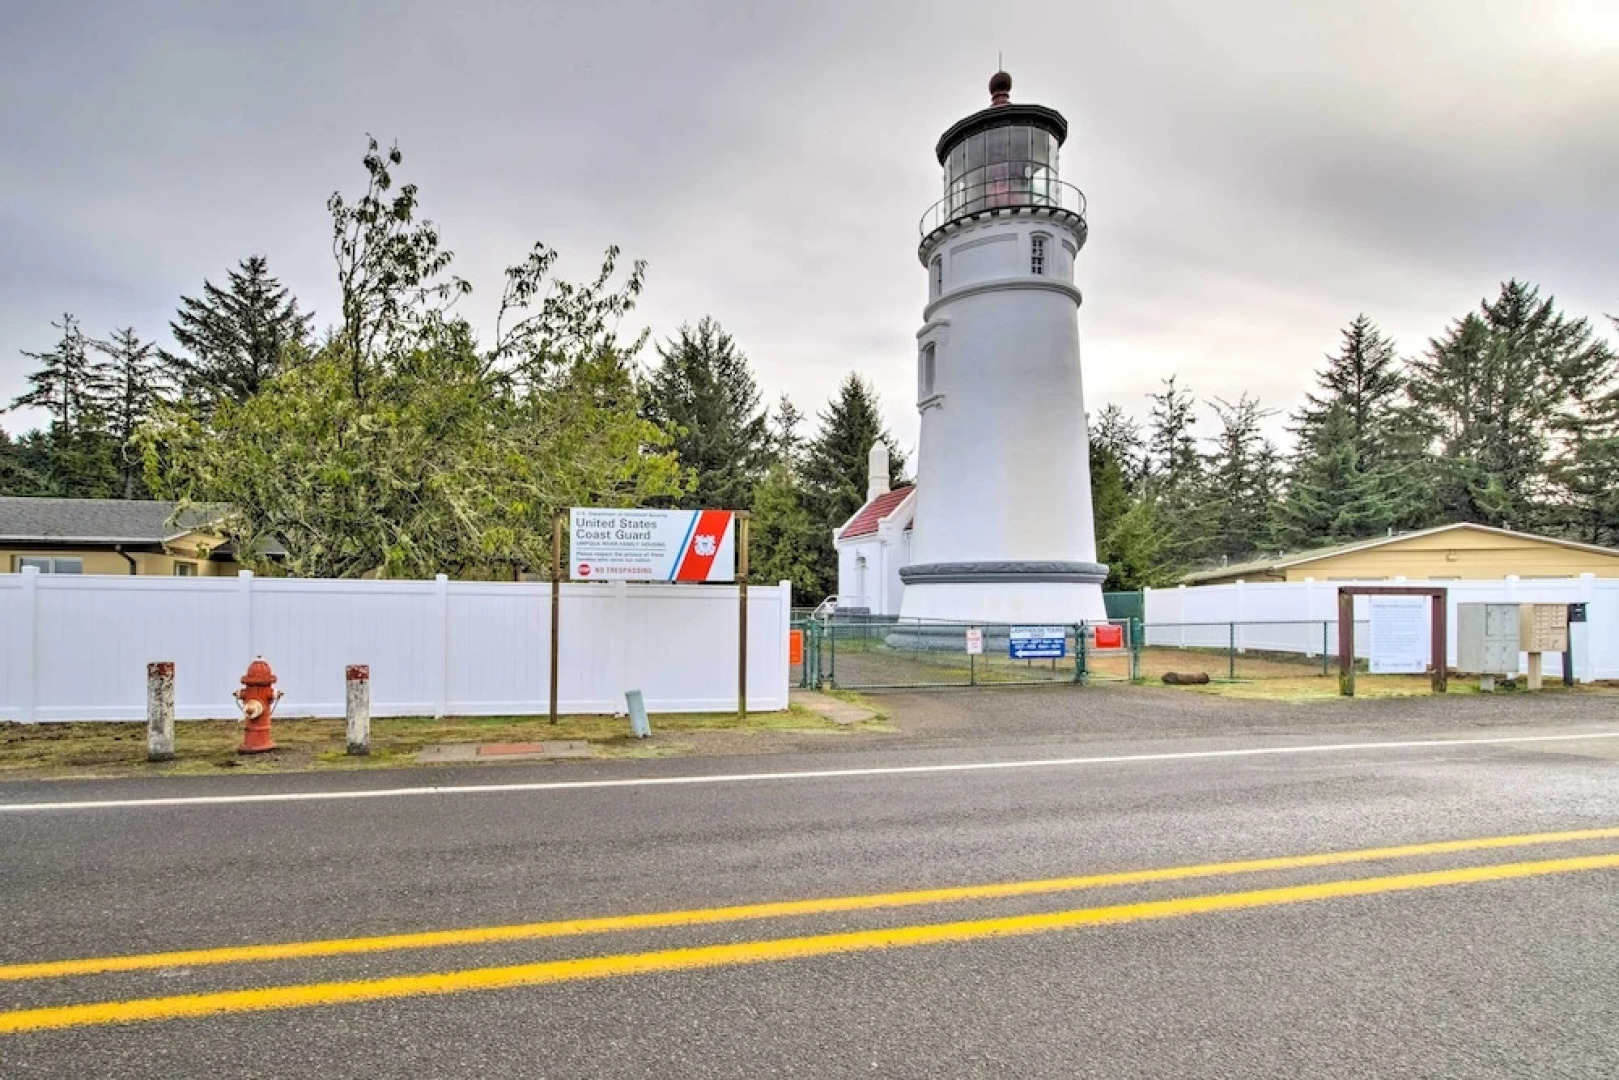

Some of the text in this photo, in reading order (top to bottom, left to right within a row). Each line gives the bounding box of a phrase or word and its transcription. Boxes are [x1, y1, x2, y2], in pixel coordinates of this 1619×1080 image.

[576, 517, 657, 529] United States
[576, 529, 651, 540] Coast Guard
